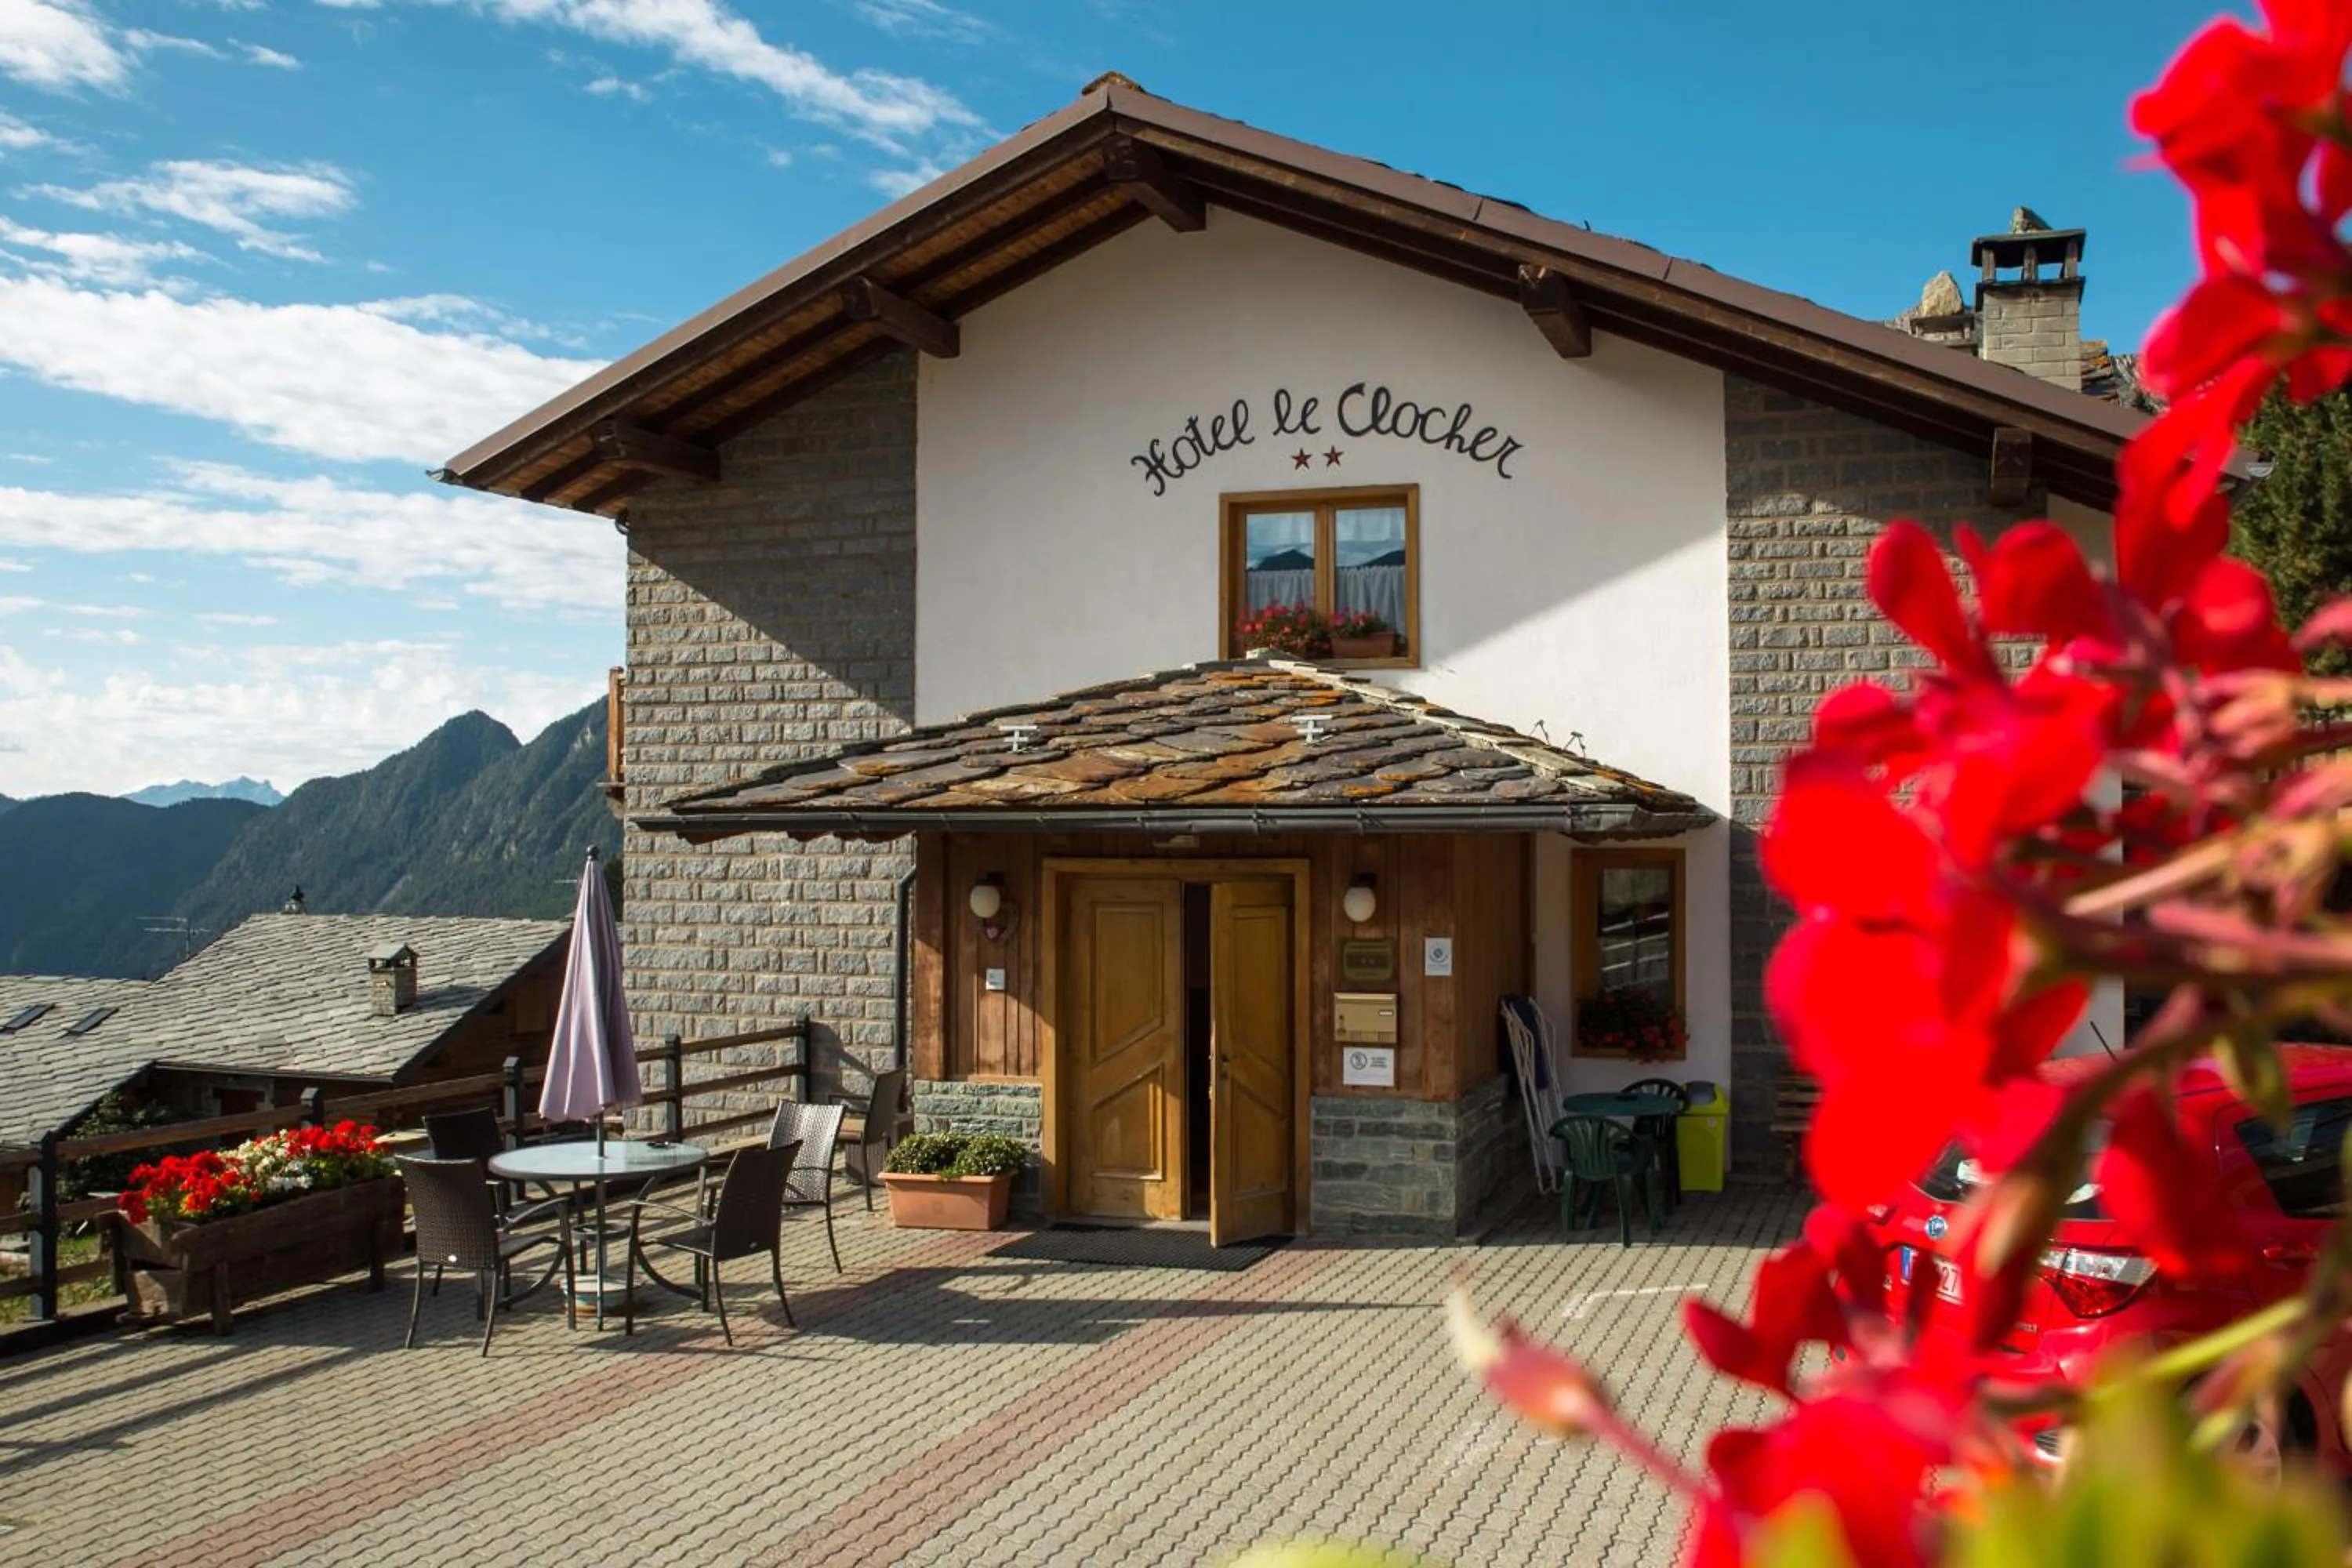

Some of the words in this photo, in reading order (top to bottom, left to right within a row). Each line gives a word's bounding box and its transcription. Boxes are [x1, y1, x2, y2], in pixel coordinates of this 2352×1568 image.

[1130, 398, 1255, 497] Hotel
[1272, 388, 1321, 437] le
[1337, 382, 1523, 480] Clocher
